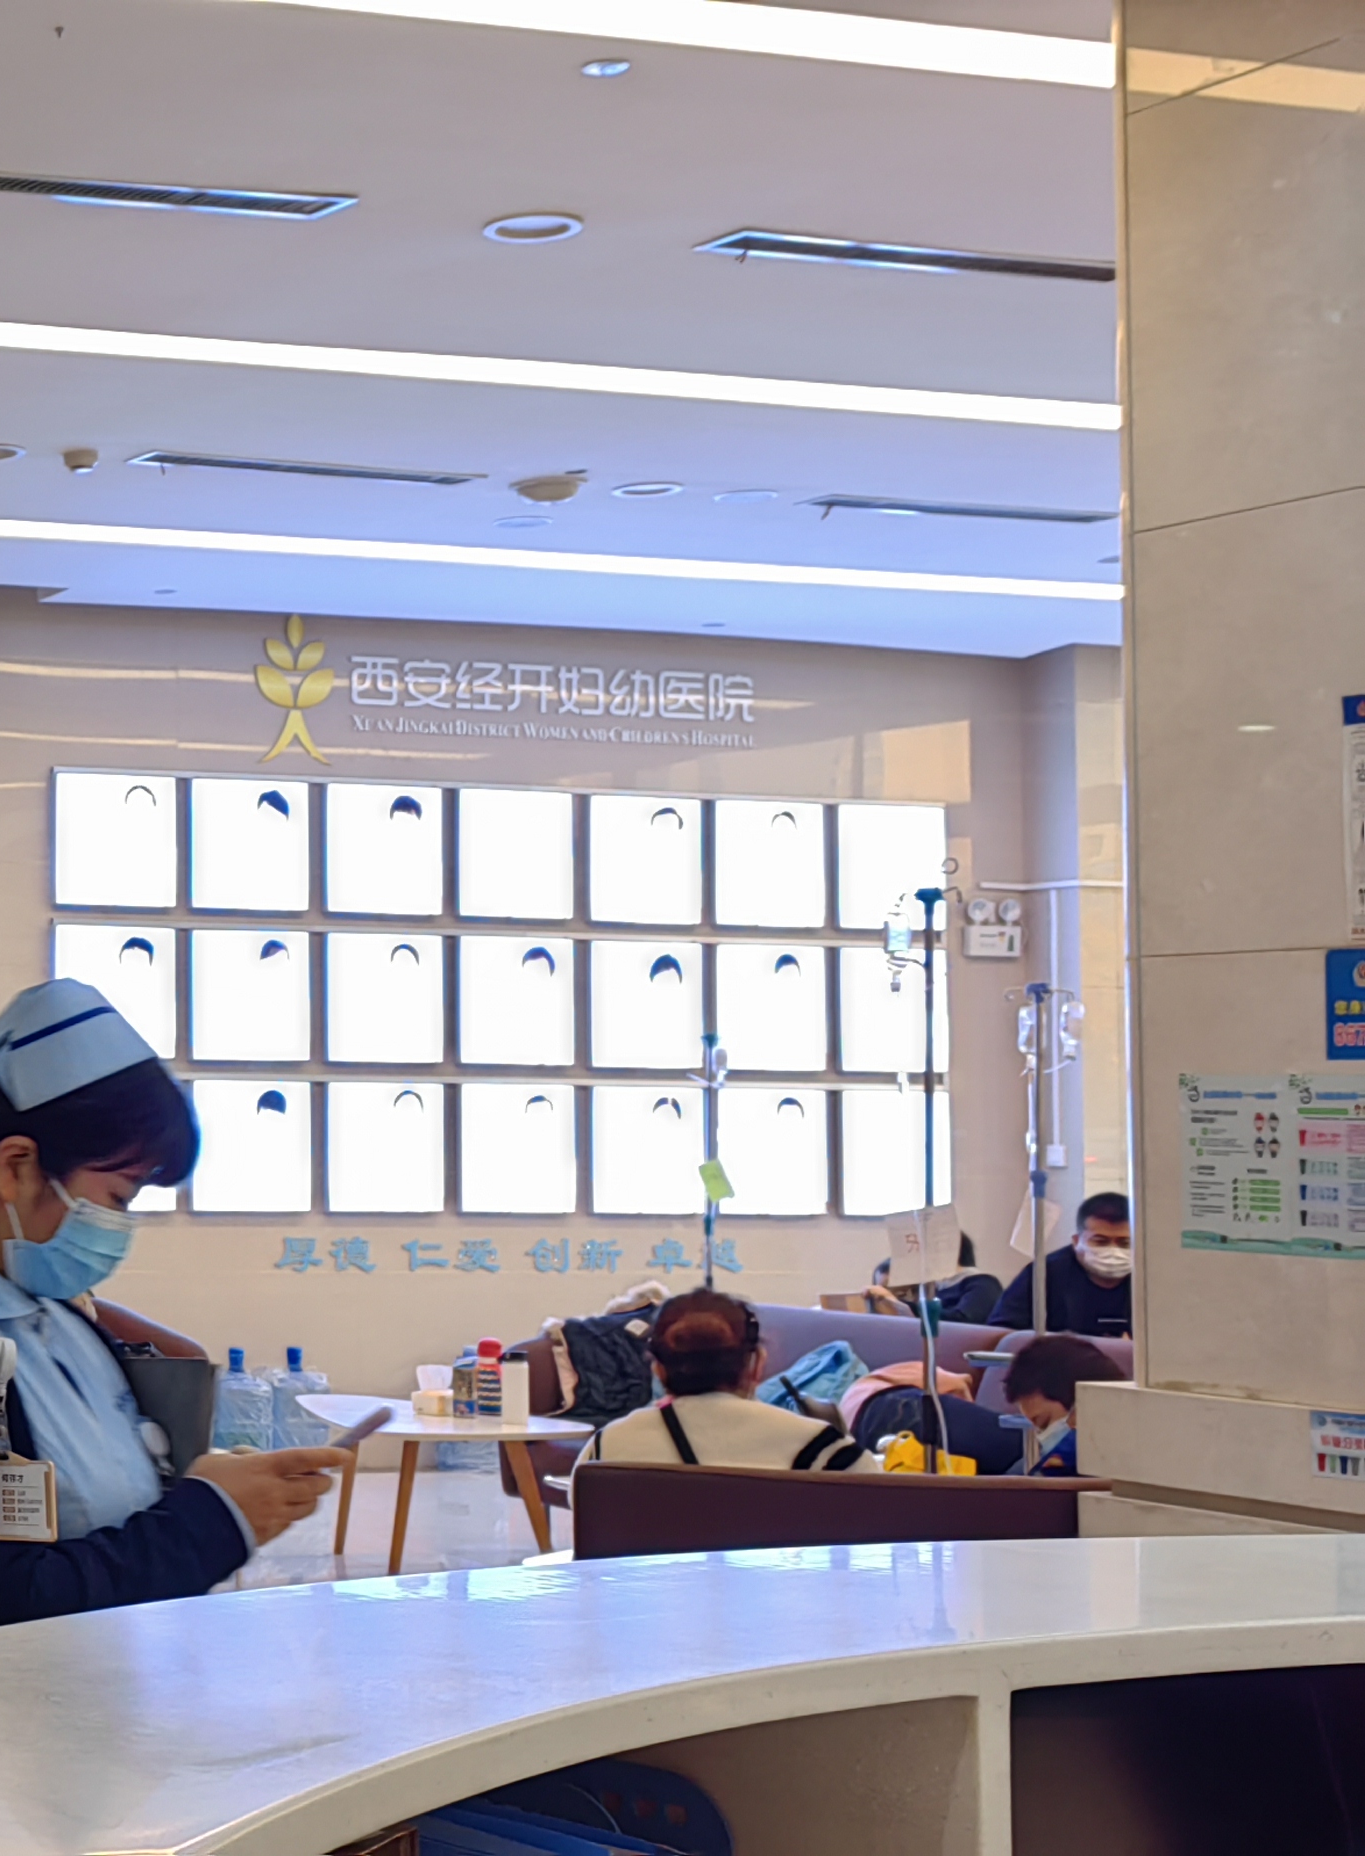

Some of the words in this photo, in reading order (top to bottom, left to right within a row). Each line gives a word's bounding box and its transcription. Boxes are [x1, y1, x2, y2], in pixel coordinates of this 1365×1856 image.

[349, 655, 756, 723] 西安经开妇幼医院
[396, 716, 453, 735] JINGKAI
[456, 719, 520, 738] DISTRICT
[523, 722, 578, 740] WOMEN
[582, 727, 607, 742] AND
[692, 729, 755, 748] HOSPITAL
[274, 1236, 377, 1273] 厚德
[402, 1239, 501, 1273] 仁爱
[524, 1238, 623, 1273] 创新
